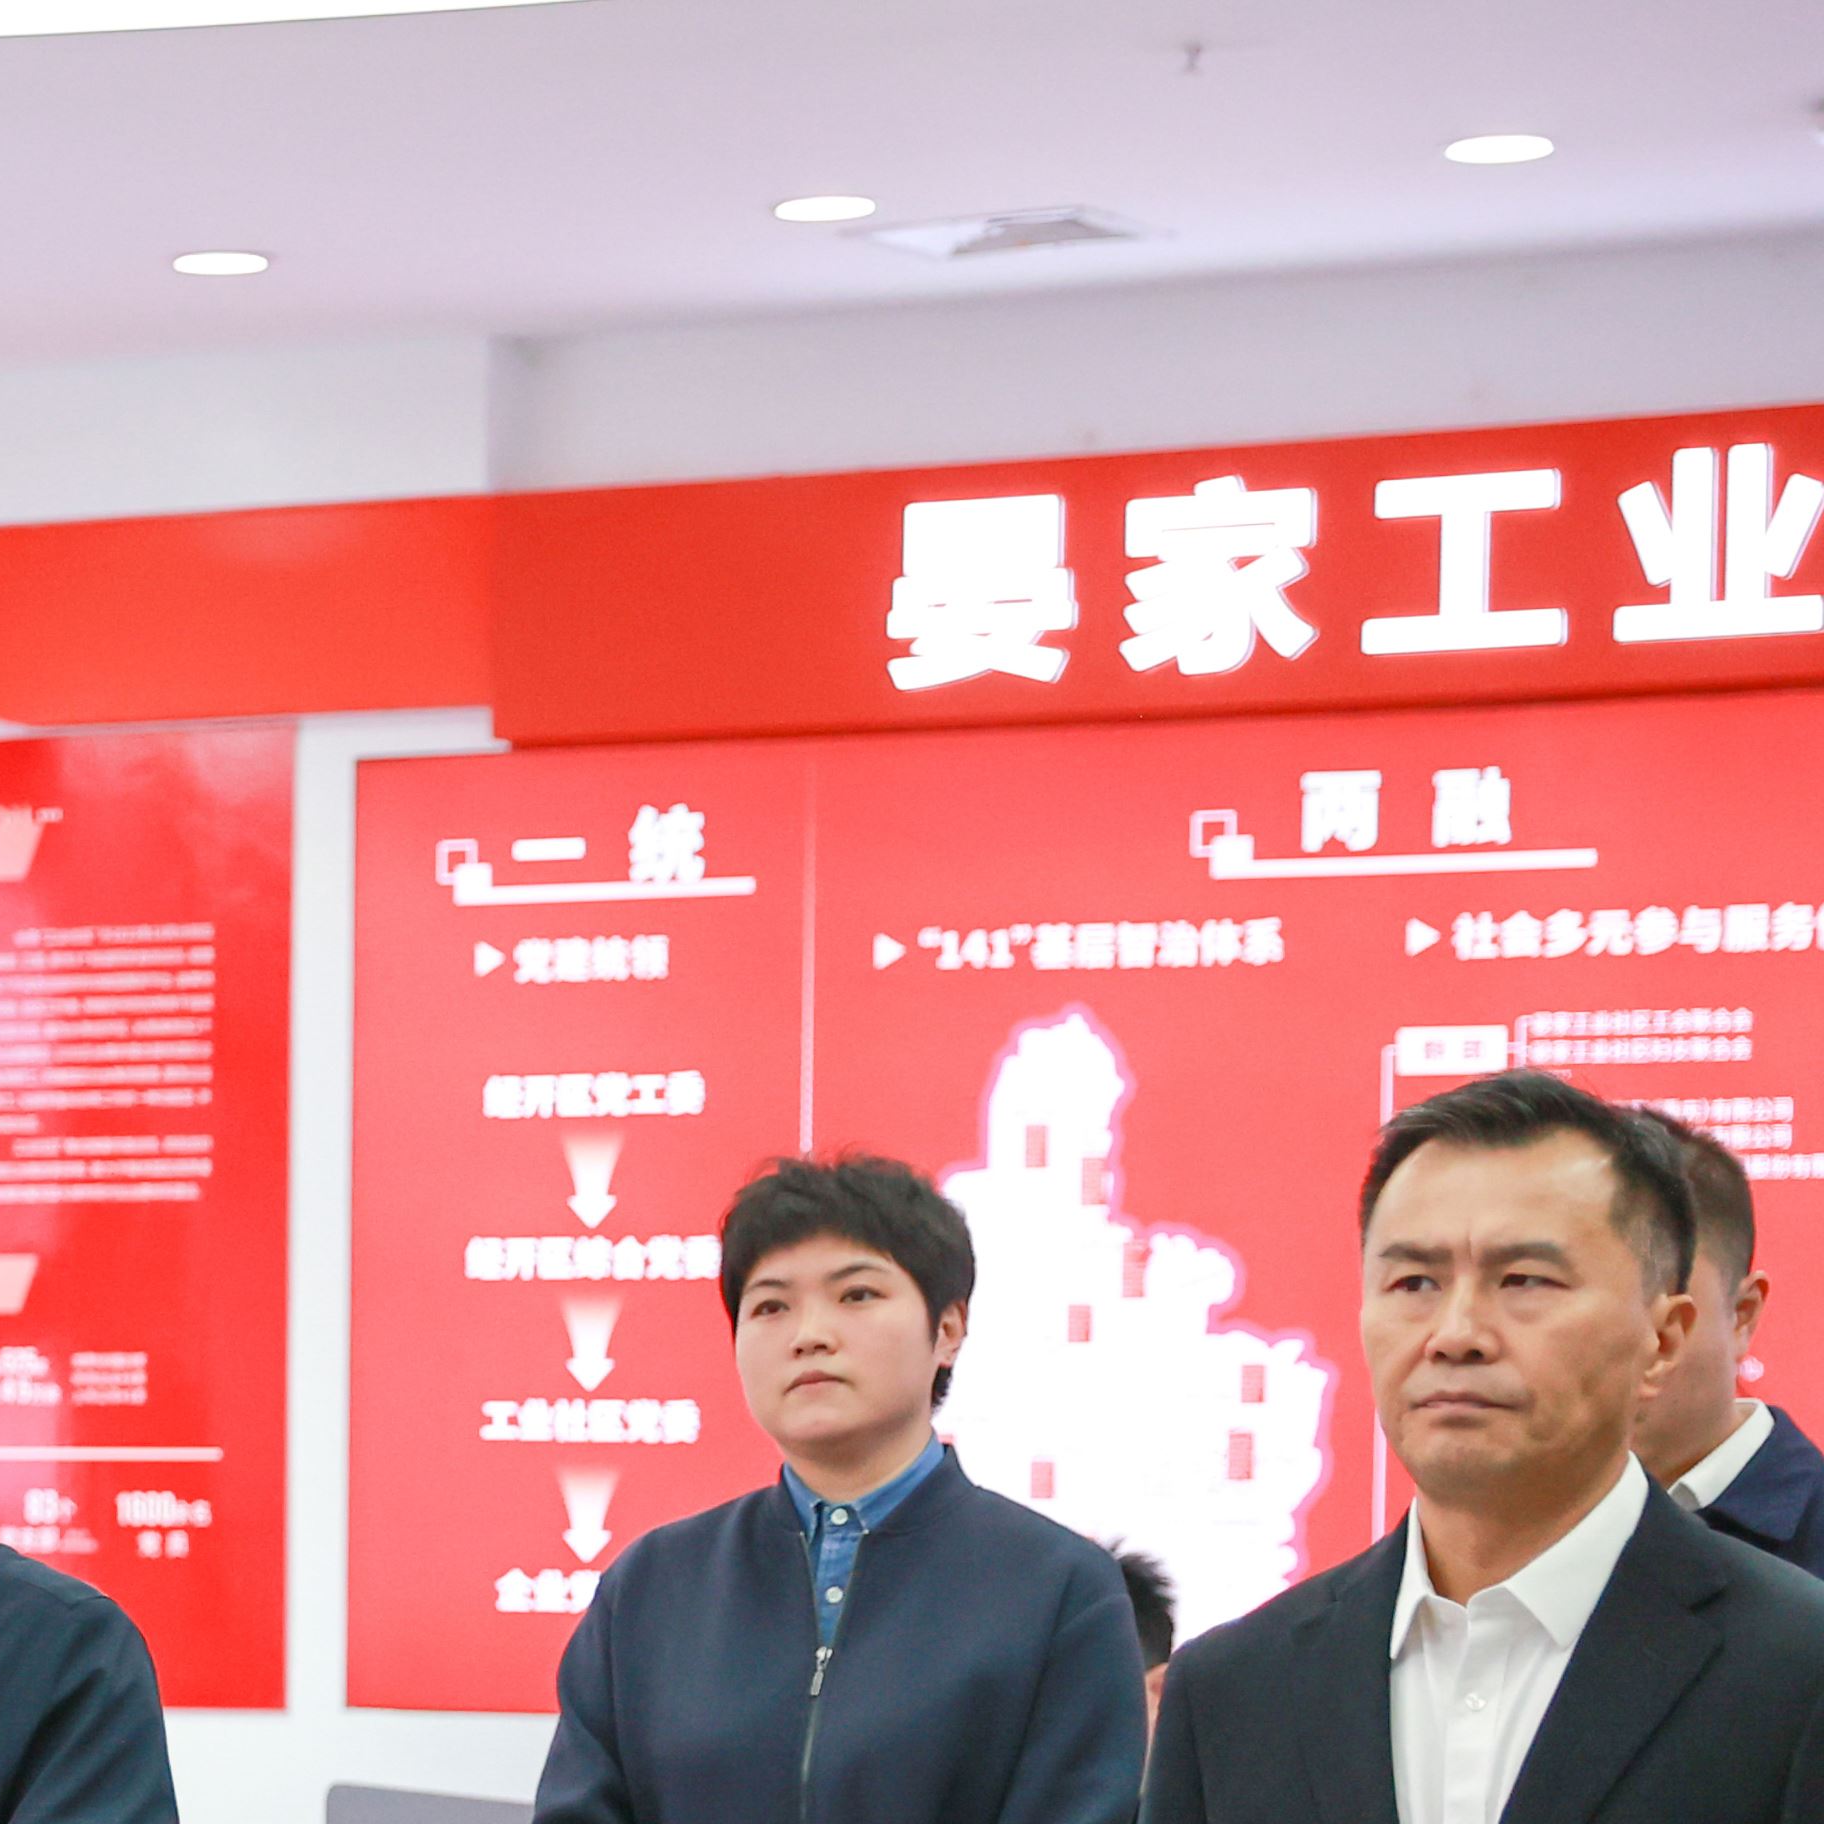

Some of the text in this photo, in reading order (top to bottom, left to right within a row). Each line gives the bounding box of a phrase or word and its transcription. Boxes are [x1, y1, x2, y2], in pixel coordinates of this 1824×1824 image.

[885, 441, 1824, 692] 晏家工业
[1300, 766, 1514, 853] 两融
